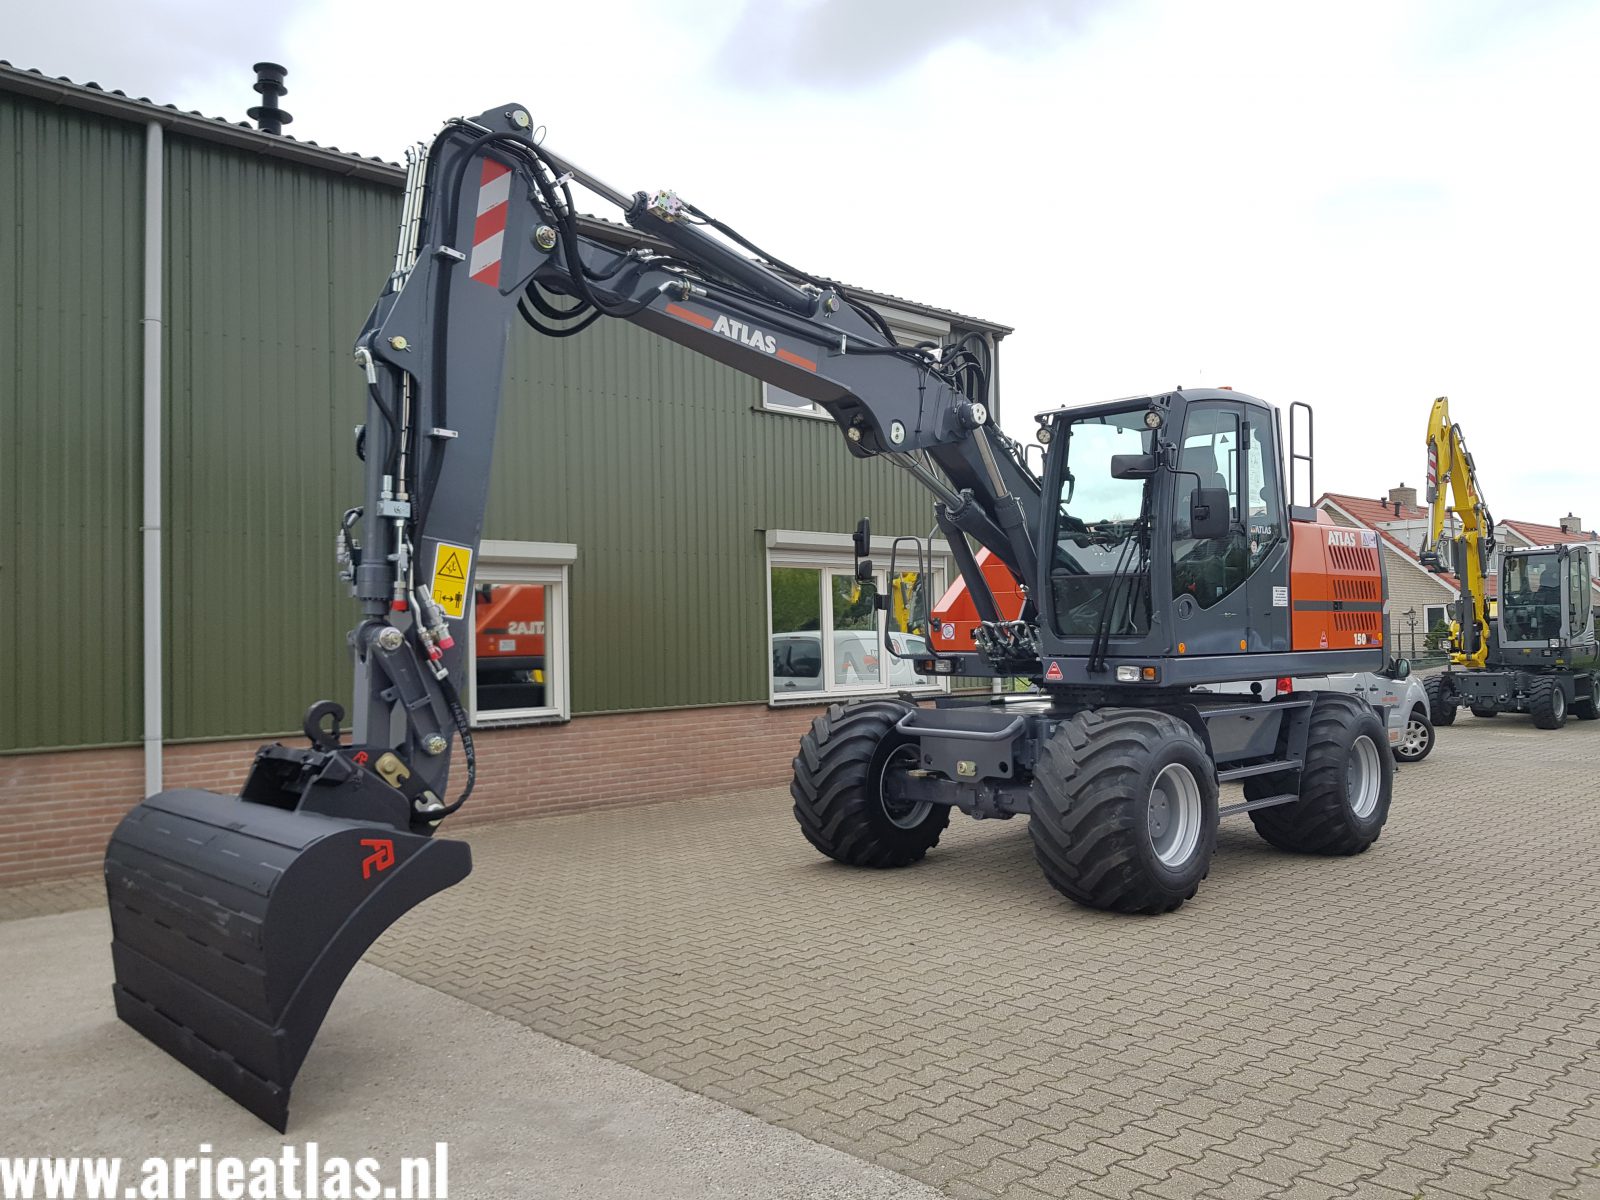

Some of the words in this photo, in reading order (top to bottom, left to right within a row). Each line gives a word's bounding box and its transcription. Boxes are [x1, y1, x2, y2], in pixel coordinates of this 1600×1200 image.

[713, 315, 777, 354] ATLAS
[1256, 525, 1272, 535] ATLAS
[1328, 531, 1356, 547] ATLAS
[450, 702, 468, 733] HANSA
